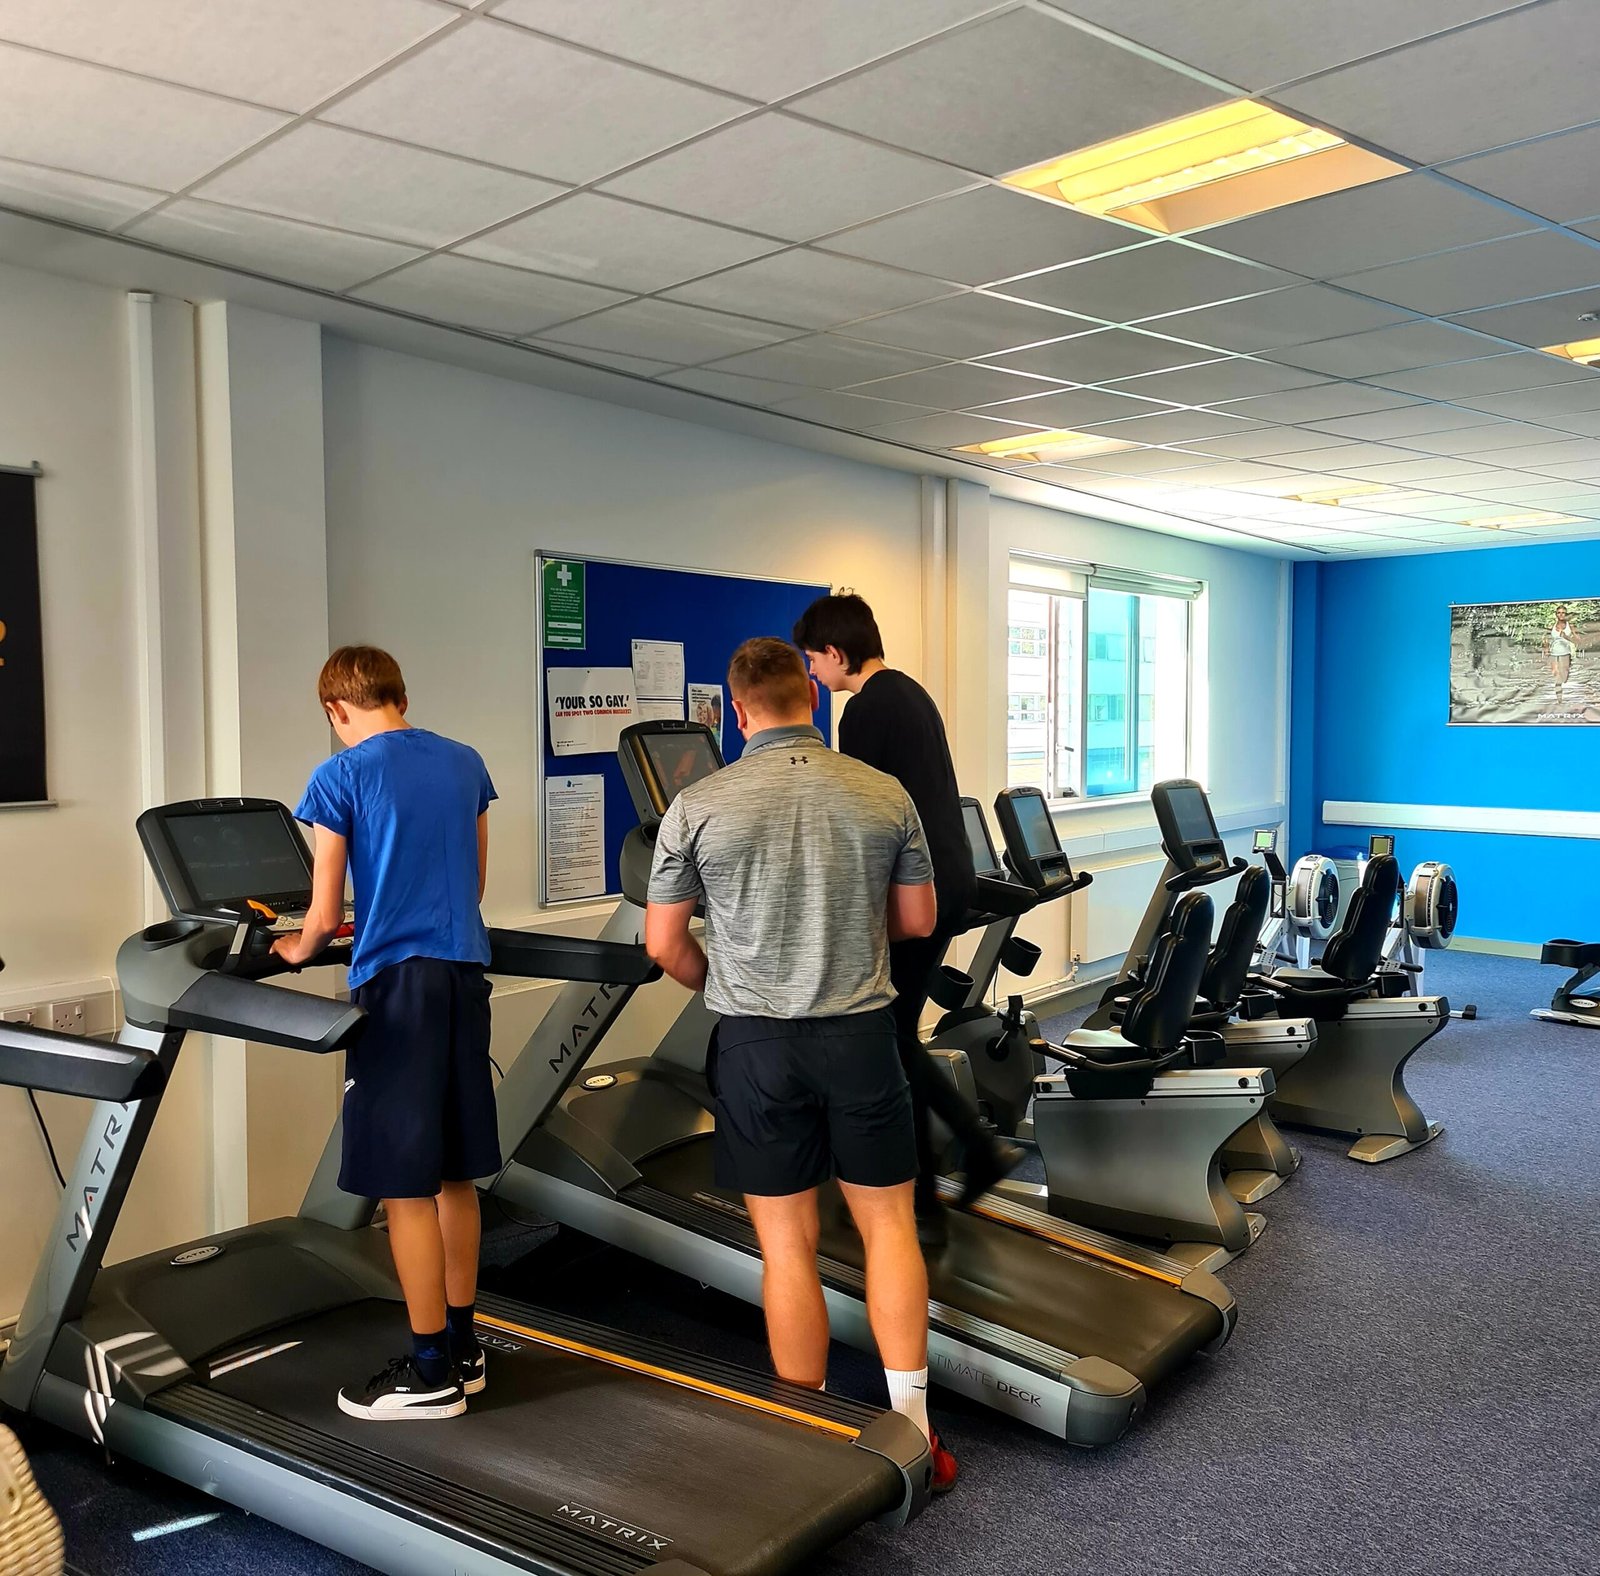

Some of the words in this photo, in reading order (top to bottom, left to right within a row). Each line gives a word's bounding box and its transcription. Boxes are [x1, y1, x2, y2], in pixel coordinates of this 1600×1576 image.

[555, 696, 586, 710] 'YOUR
[589, 695, 603, 708] SO
[606, 695, 630, 708] GAY.'
[549, 983, 621, 1074] MATR
[66, 1103, 129, 1252] MATRI
[176, 1247, 217, 1261] MATRIX
[474, 1332, 522, 1351] MAT
[934, 1352, 993, 1386] TIMATE
[996, 1380, 1042, 1408] DECK
[557, 1504, 668, 1551] MATRIX
